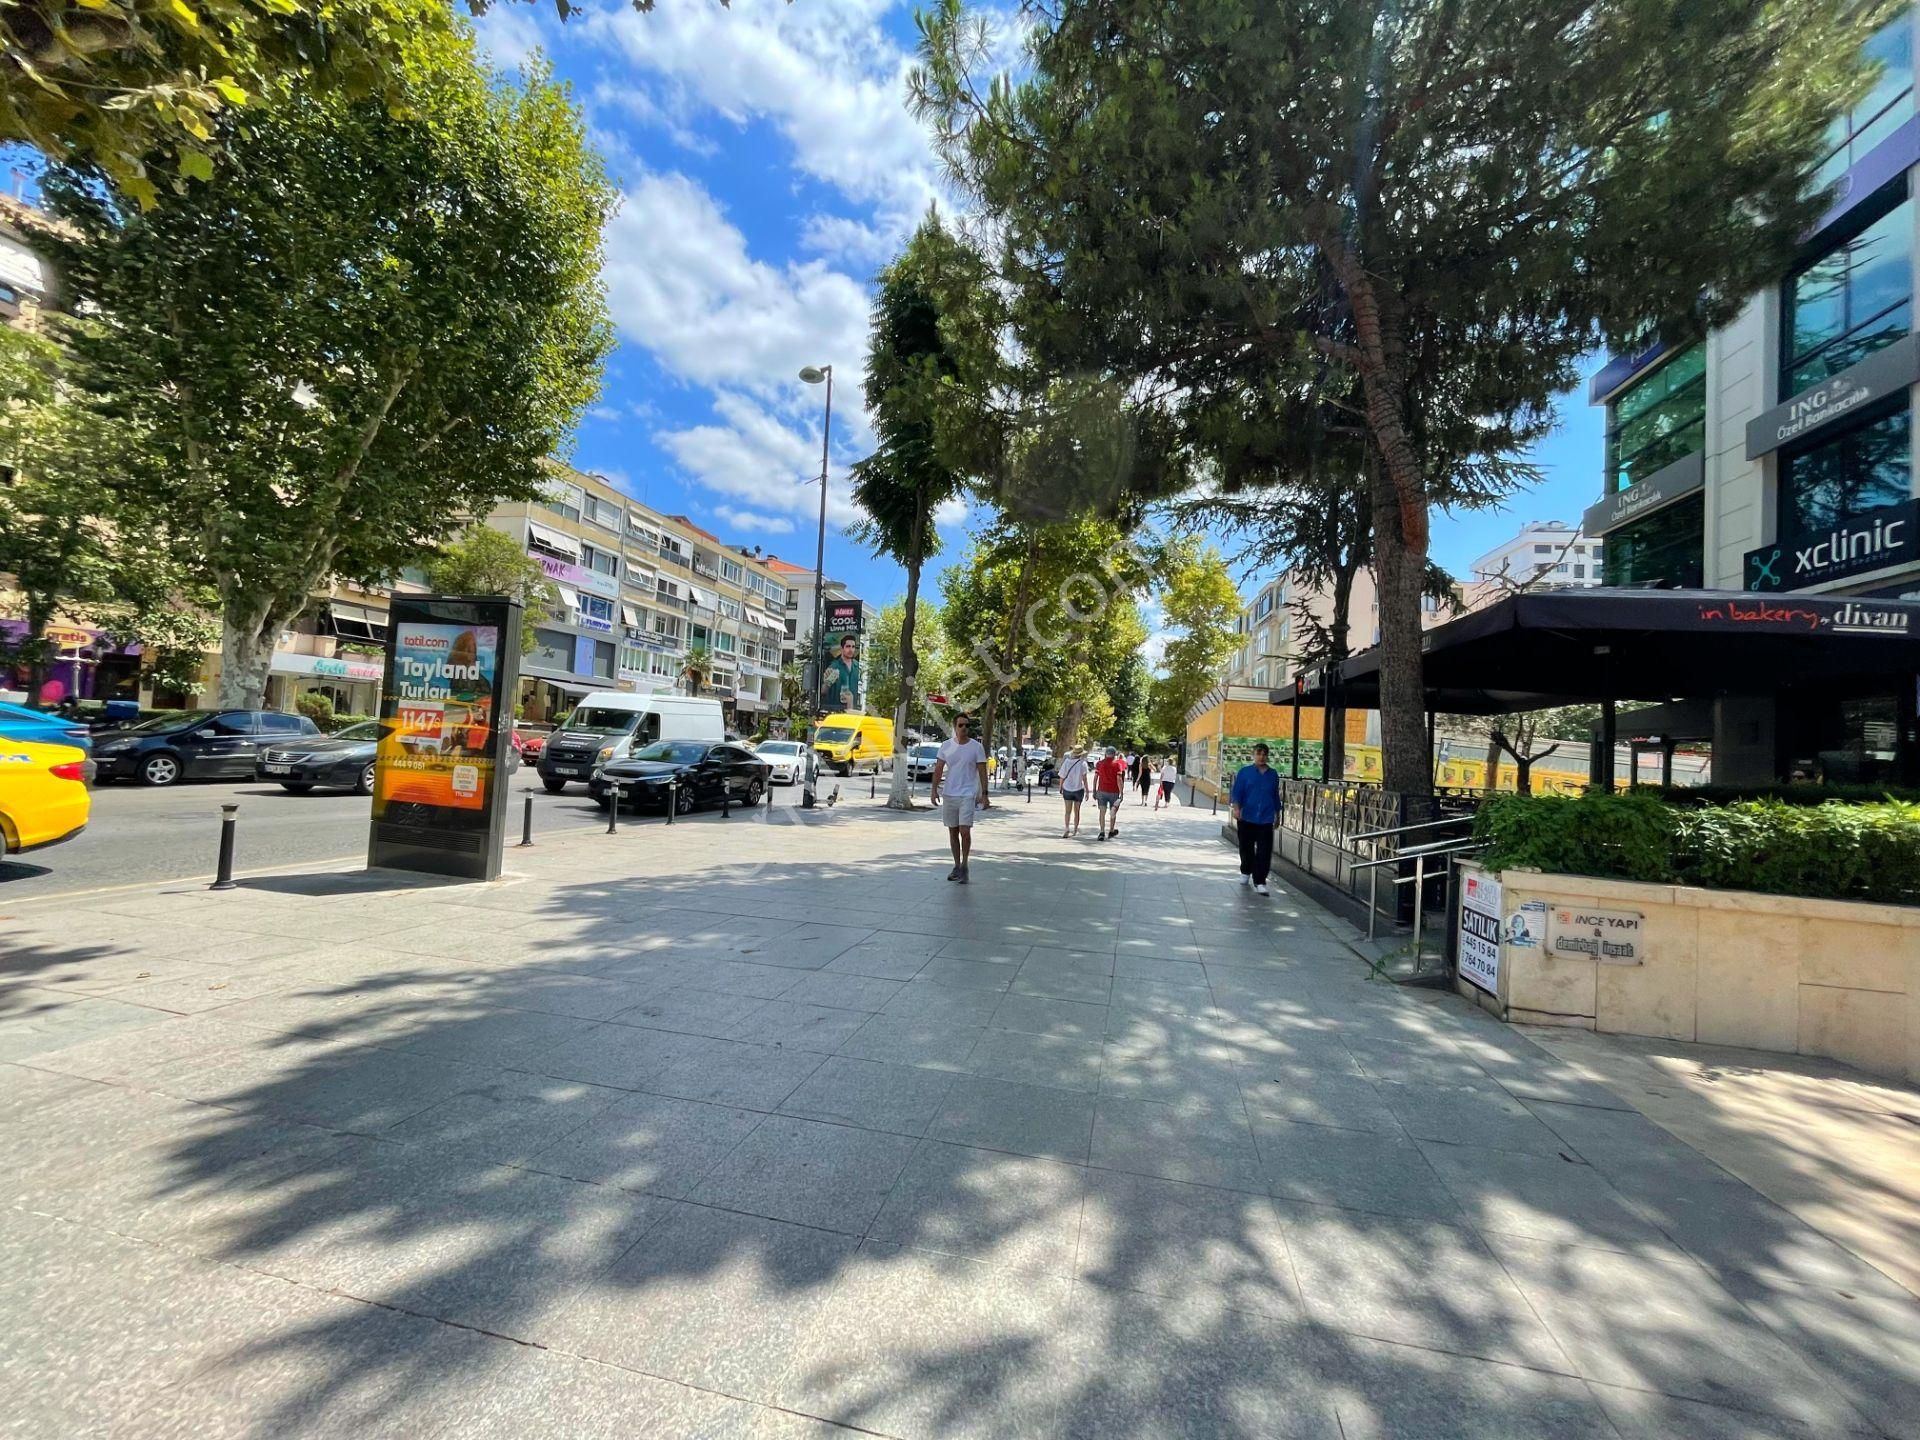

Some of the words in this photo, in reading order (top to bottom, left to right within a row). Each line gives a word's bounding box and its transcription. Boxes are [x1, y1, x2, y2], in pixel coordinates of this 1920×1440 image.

[1789, 391, 1827, 420] ING
[1777, 419, 1803, 440] Özel
[1618, 489, 1639, 508] ING
[1795, 518, 1905, 574] xclinic
[831, 617, 857, 626] COOL
[1700, 605, 1724, 620] in
[1728, 602, 1820, 630] bakery
[1833, 603, 1909, 627] divan
[404, 634, 449, 648] tatil.com
[401, 656, 480, 681] Tayland
[400, 681, 451, 700] Turları
[393, 759, 406, 768] 444
[1463, 909, 1498, 943] SATILIK
[1593, 928, 1602, 937] &
[1608, 917, 1638, 930] YAPI
[1477, 941, 1486, 955] 15
[1486, 946, 1496, 960] 84
[1477, 957, 1486, 973] 70
[1486, 964, 1496, 978] 84
